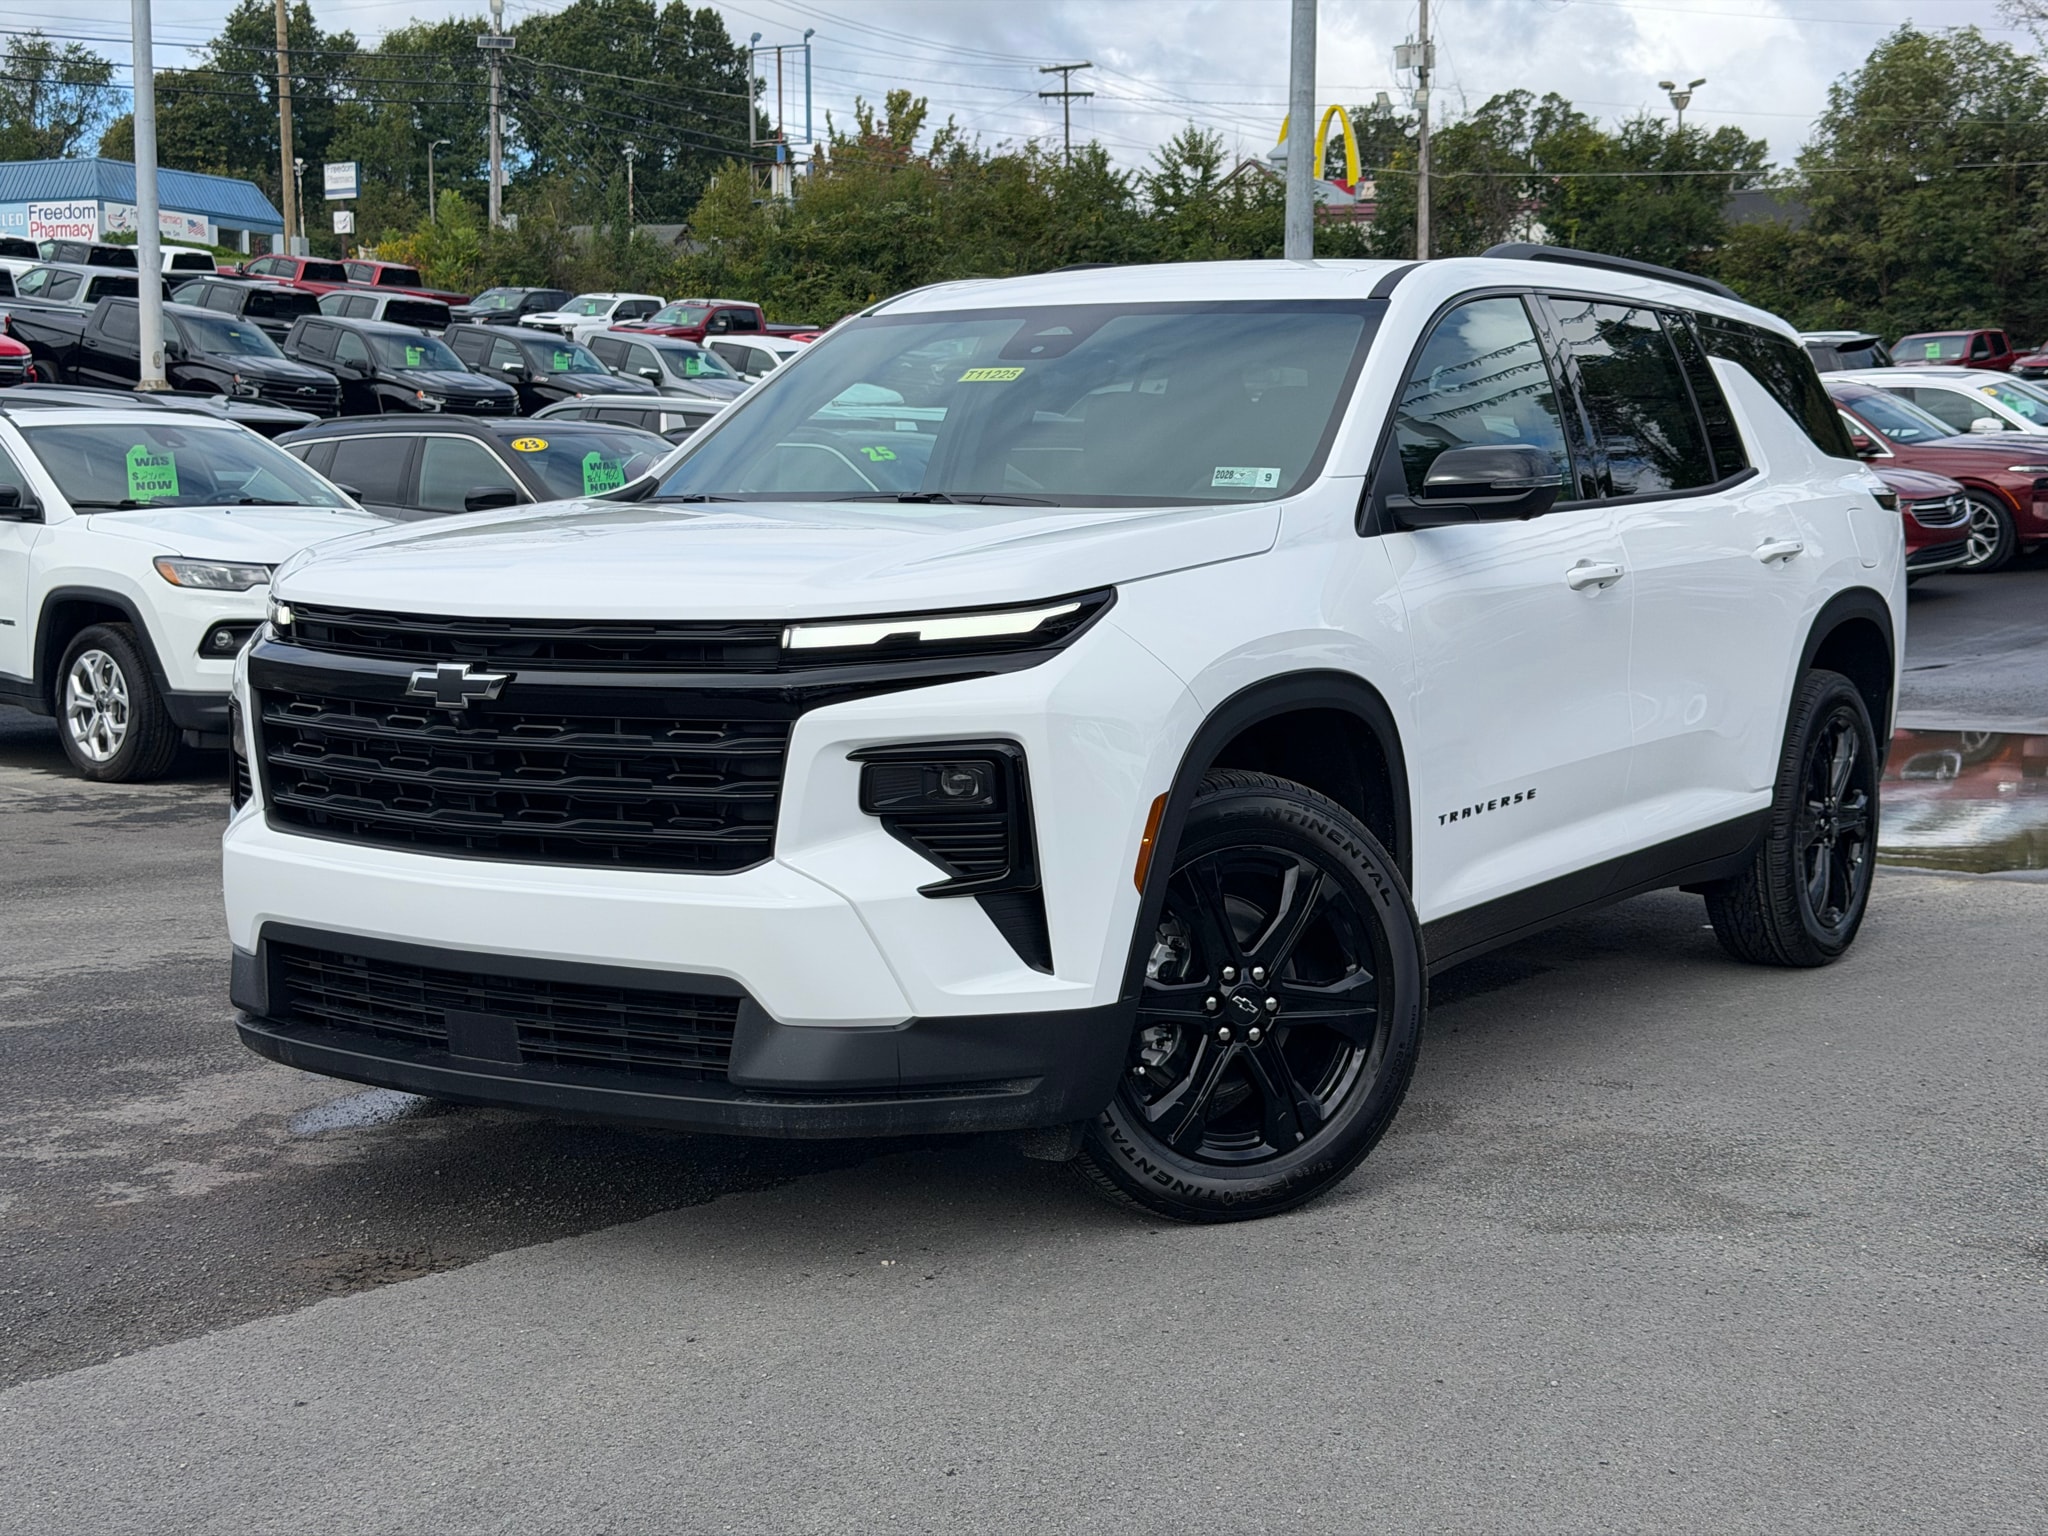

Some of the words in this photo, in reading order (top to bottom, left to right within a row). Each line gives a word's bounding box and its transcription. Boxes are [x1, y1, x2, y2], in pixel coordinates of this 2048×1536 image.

[28, 203, 96, 221] Freedom
[30, 221, 95, 241] Pharmacy
[966, 369, 1021, 380] T11225
[520, 439, 540, 450] 23
[860, 446, 897, 462] 25
[134, 457, 170, 467] WAS
[1215, 470, 1235, 480] 2028
[1264, 473, 1273, 482] 9
[135, 480, 173, 491] NOW
[590, 482, 620, 492] NOW
[1437, 788, 1537, 826] TRAVERSE
